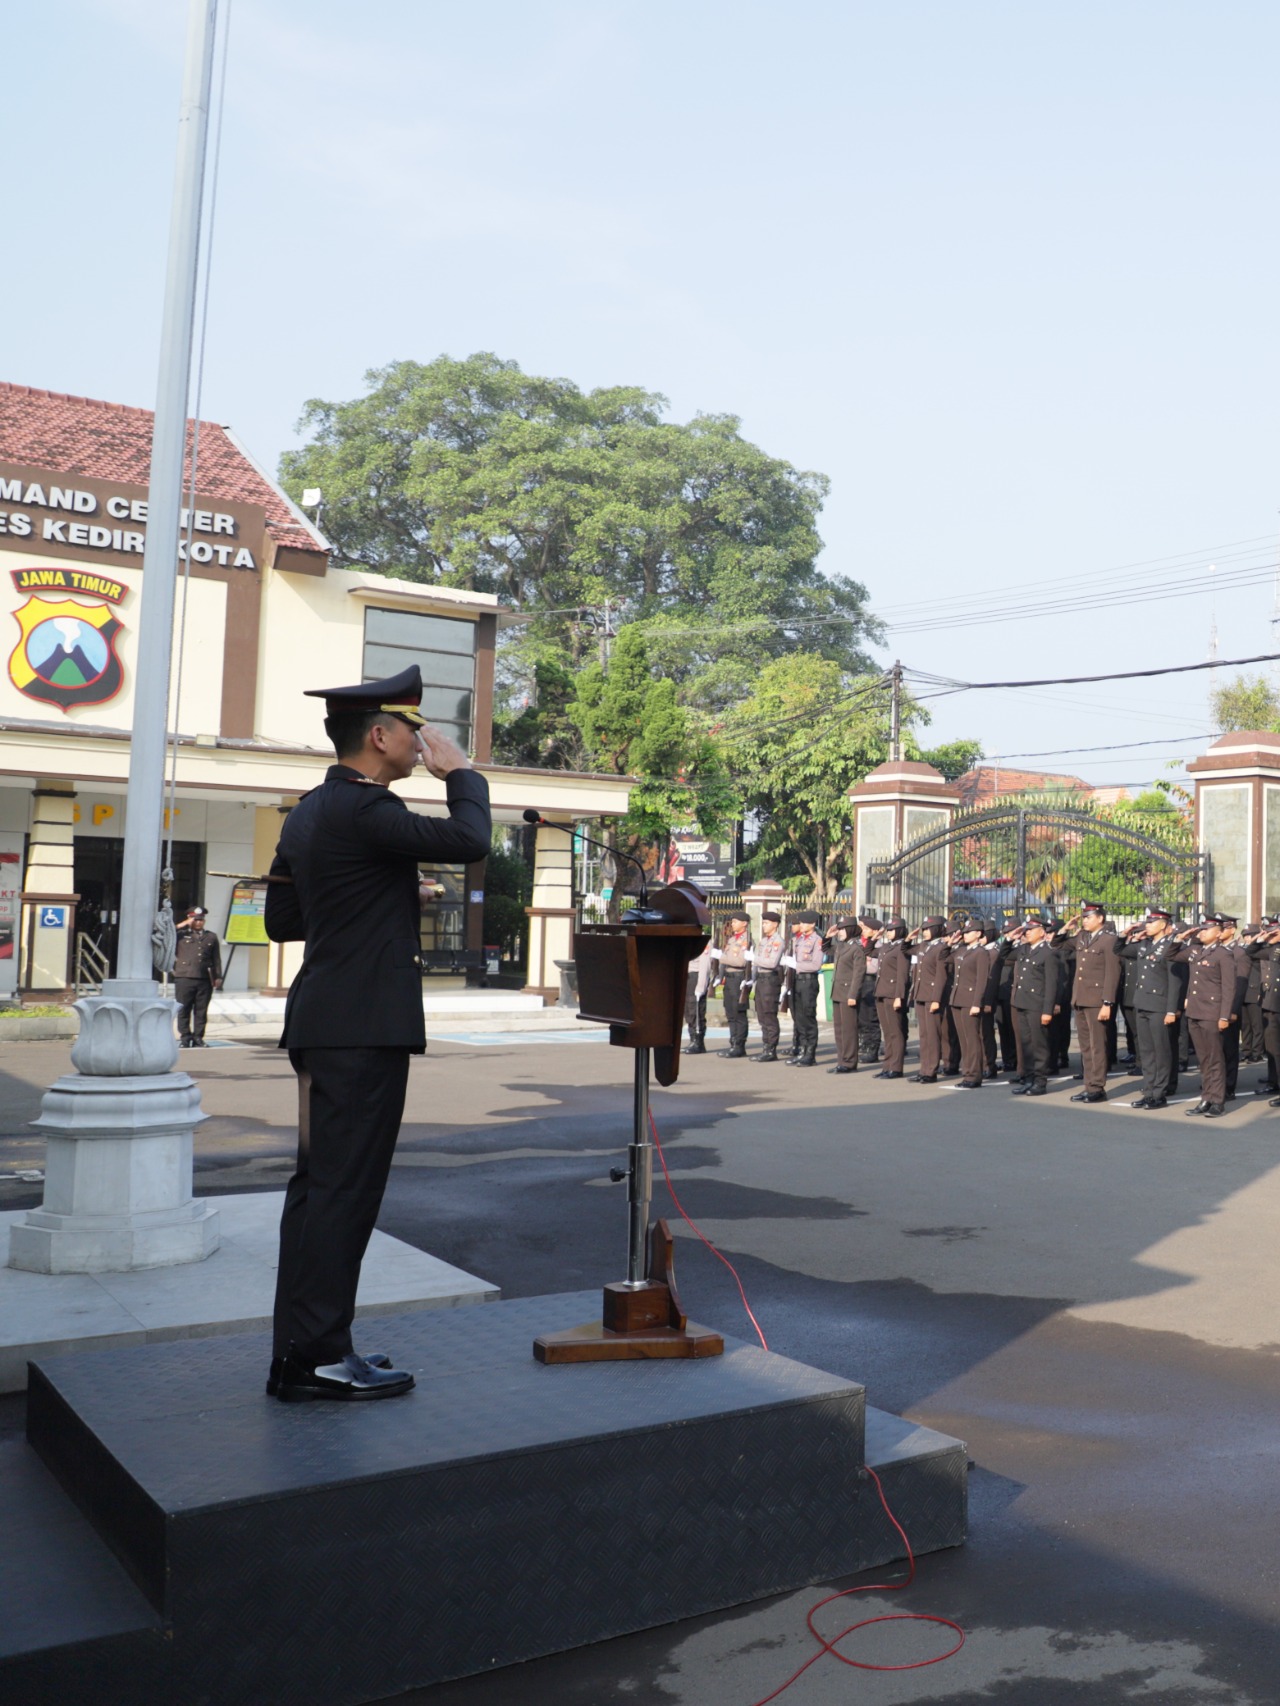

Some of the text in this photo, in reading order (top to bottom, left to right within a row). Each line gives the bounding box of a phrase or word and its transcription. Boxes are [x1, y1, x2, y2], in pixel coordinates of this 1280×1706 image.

[106, 496, 235, 535] CETER
[43, 517, 145, 554] KEDIR
[20, 571, 122, 599] JAWA TIMUR
